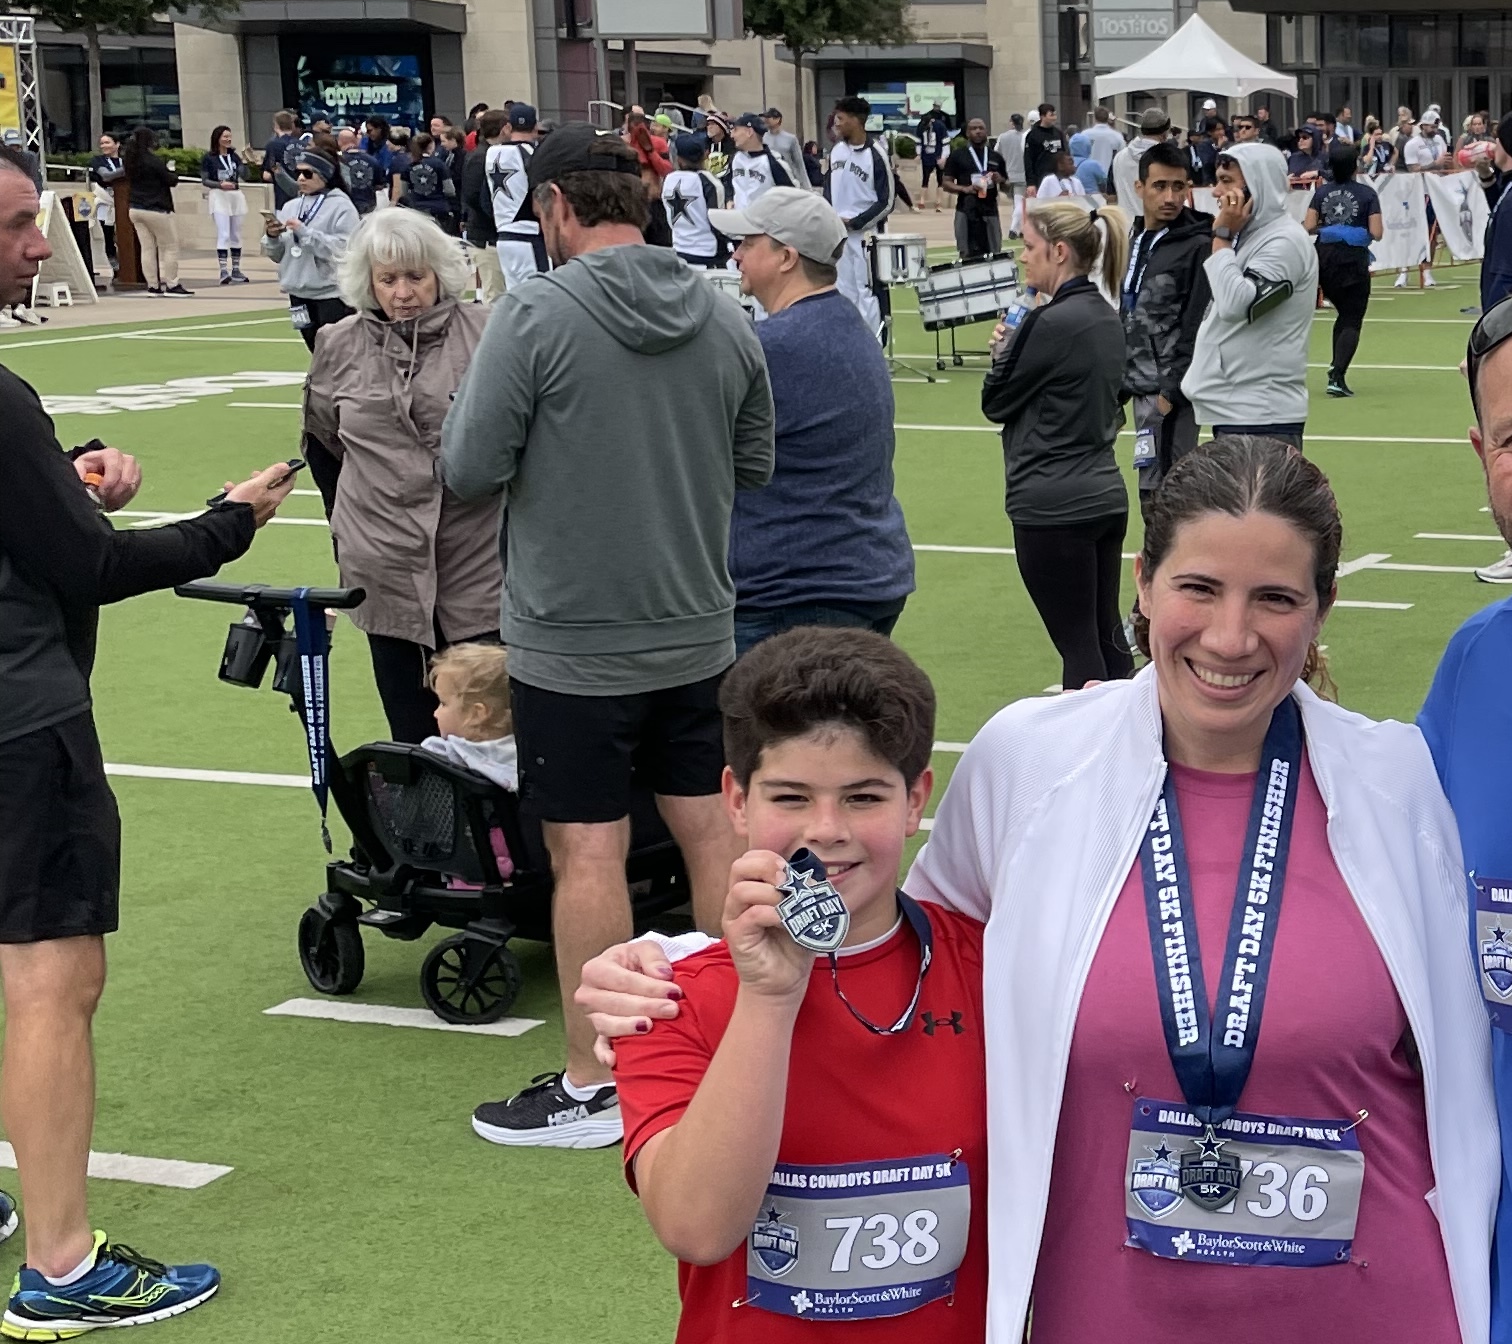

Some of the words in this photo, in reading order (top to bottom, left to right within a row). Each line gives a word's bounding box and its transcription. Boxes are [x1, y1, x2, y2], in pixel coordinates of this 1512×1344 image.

[1260, 758, 1290, 871] FINISHER
[1151, 833, 1179, 883] DAY
[1158, 885, 1182, 920] 5K
[1247, 870, 1273, 905] 5K
[788, 905, 820, 936] DRAFT
[818, 897, 844, 916] DAY
[1239, 905, 1267, 957] DAY
[1161, 920, 1199, 1047] FINISHER
[1223, 956, 1257, 1049] DRAFT
[547, 1104, 590, 1127] HOKA
[1216, 1119, 1266, 1136] WBOYS
[1266, 1123, 1304, 1139] DRAFT
[808, 1170, 871, 1189] COWBOYS
[872, 1167, 909, 1185] DRAFT
[911, 1165, 934, 1182] DAY
[935, 1162, 952, 1178] 5K
[1133, 1173, 1164, 1190] DRAFT
[1164, 1174, 1183, 1194] DA
[1181, 1168, 1216, 1185] DRAFT
[1217, 1169, 1240, 1187] DAY
[1200, 1184, 1221, 1194] 5K
[825, 1208, 941, 1272] 738
[1197, 1232, 1306, 1254] BaylorScott&White
[814, 1286, 922, 1306] BaylorScott&White
